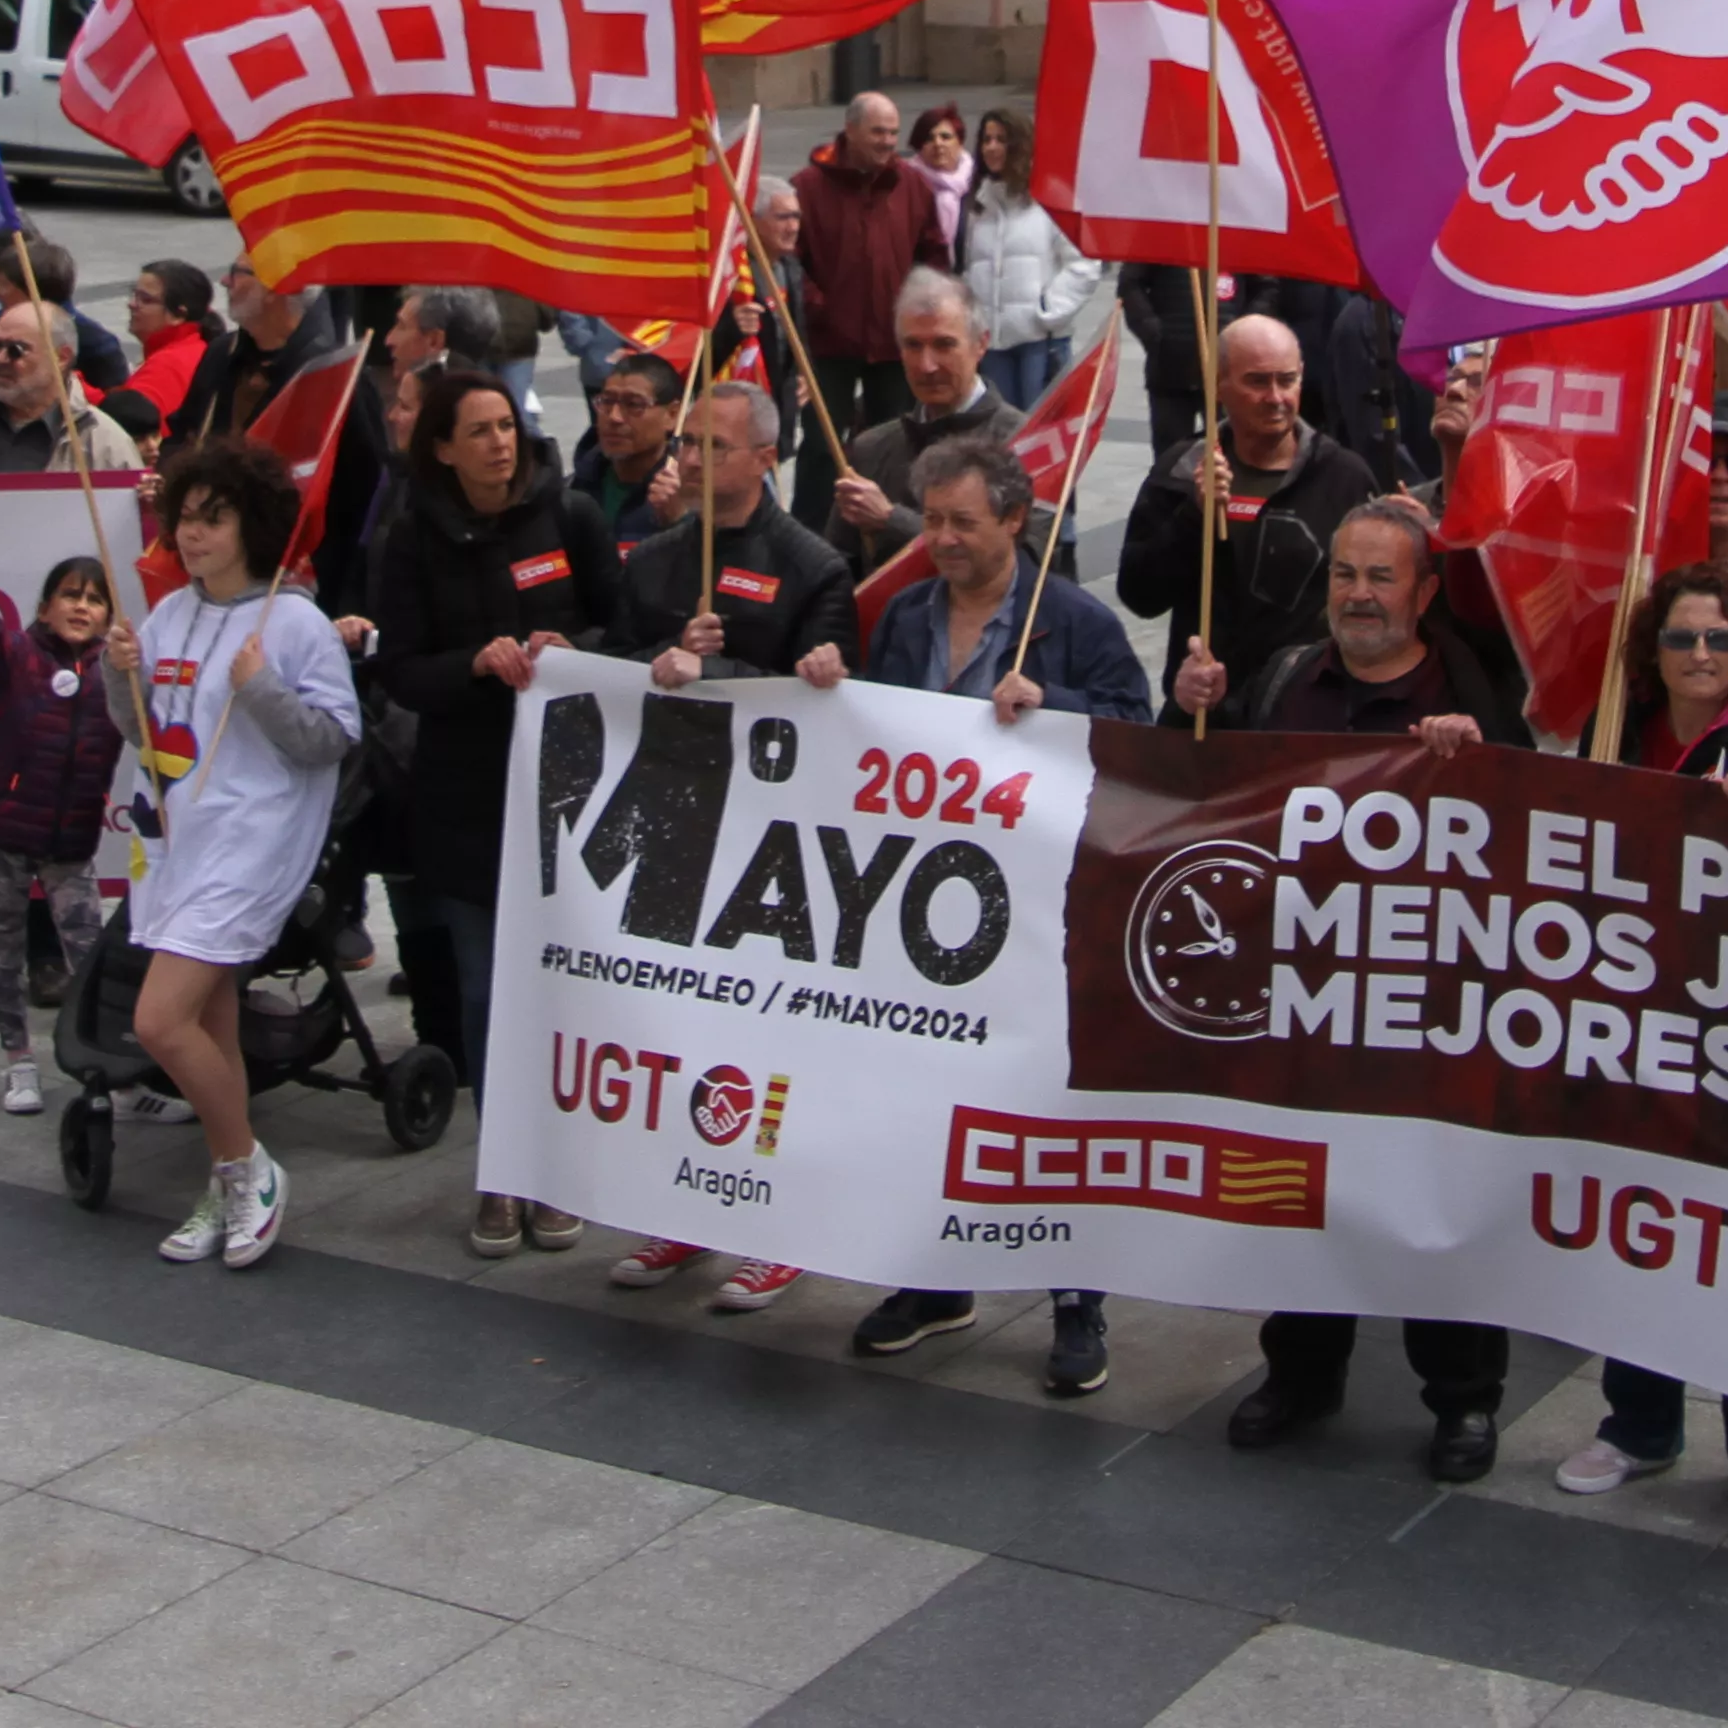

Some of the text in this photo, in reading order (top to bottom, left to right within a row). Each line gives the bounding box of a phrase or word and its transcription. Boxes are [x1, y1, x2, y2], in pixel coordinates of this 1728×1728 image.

[539, 692, 1011, 987] MAYO
[853, 748, 1034, 829] 2024
[1278, 787, 1492, 878] POR
[1527, 809, 1648, 902] EL
[1272, 876, 1656, 993] MENOS
[542, 944, 755, 1006] #PLENOEMPLEO
[786, 989, 989, 1045] #1MAYO2024
[553, 1032, 680, 1131] UGT
[674, 1157, 772, 1207] Aragón
[961, 1127, 1204, 1197] CCOO
[941, 1214, 1071, 1249] Aragón
